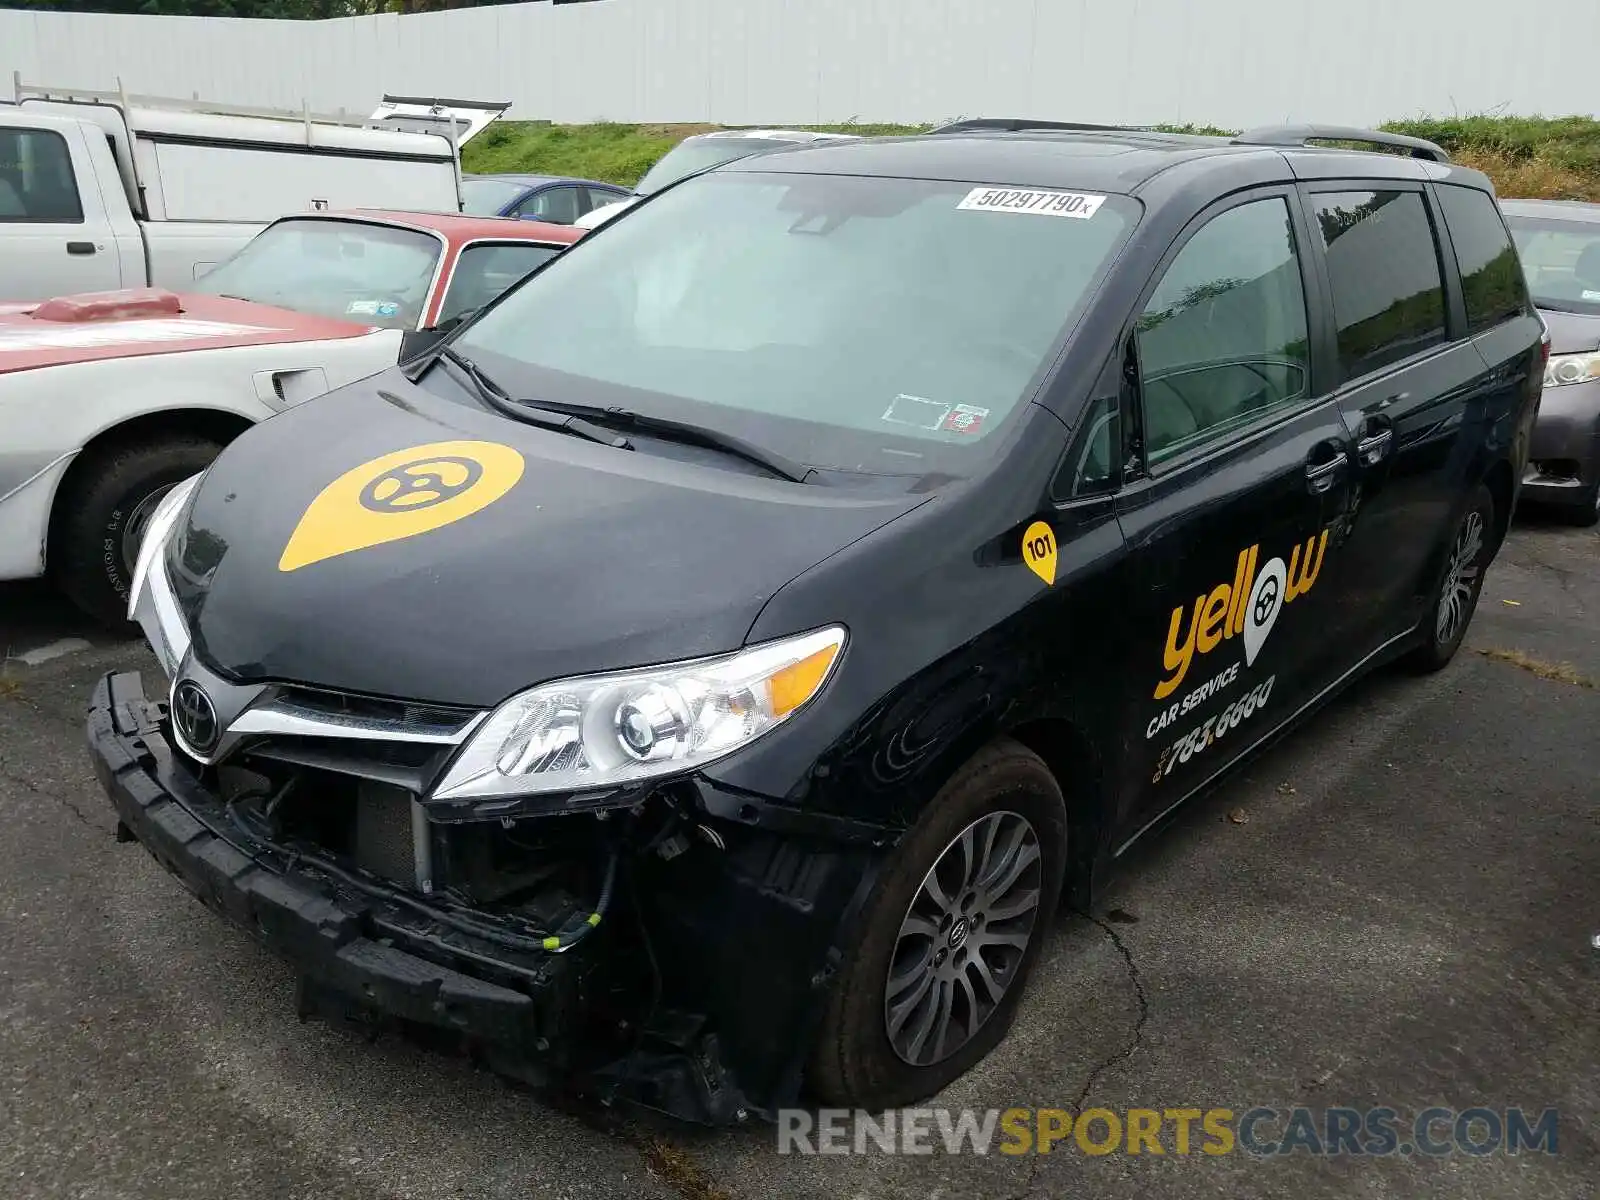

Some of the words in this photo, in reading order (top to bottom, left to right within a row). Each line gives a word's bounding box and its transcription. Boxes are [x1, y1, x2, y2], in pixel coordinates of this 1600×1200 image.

[1027, 534, 1052, 561] 101
[1153, 529, 1329, 700] yellow
[1146, 702, 1180, 739] CAR
[1179, 660, 1241, 716] SERVICE
[1164, 674, 1276, 775] 783.6660
